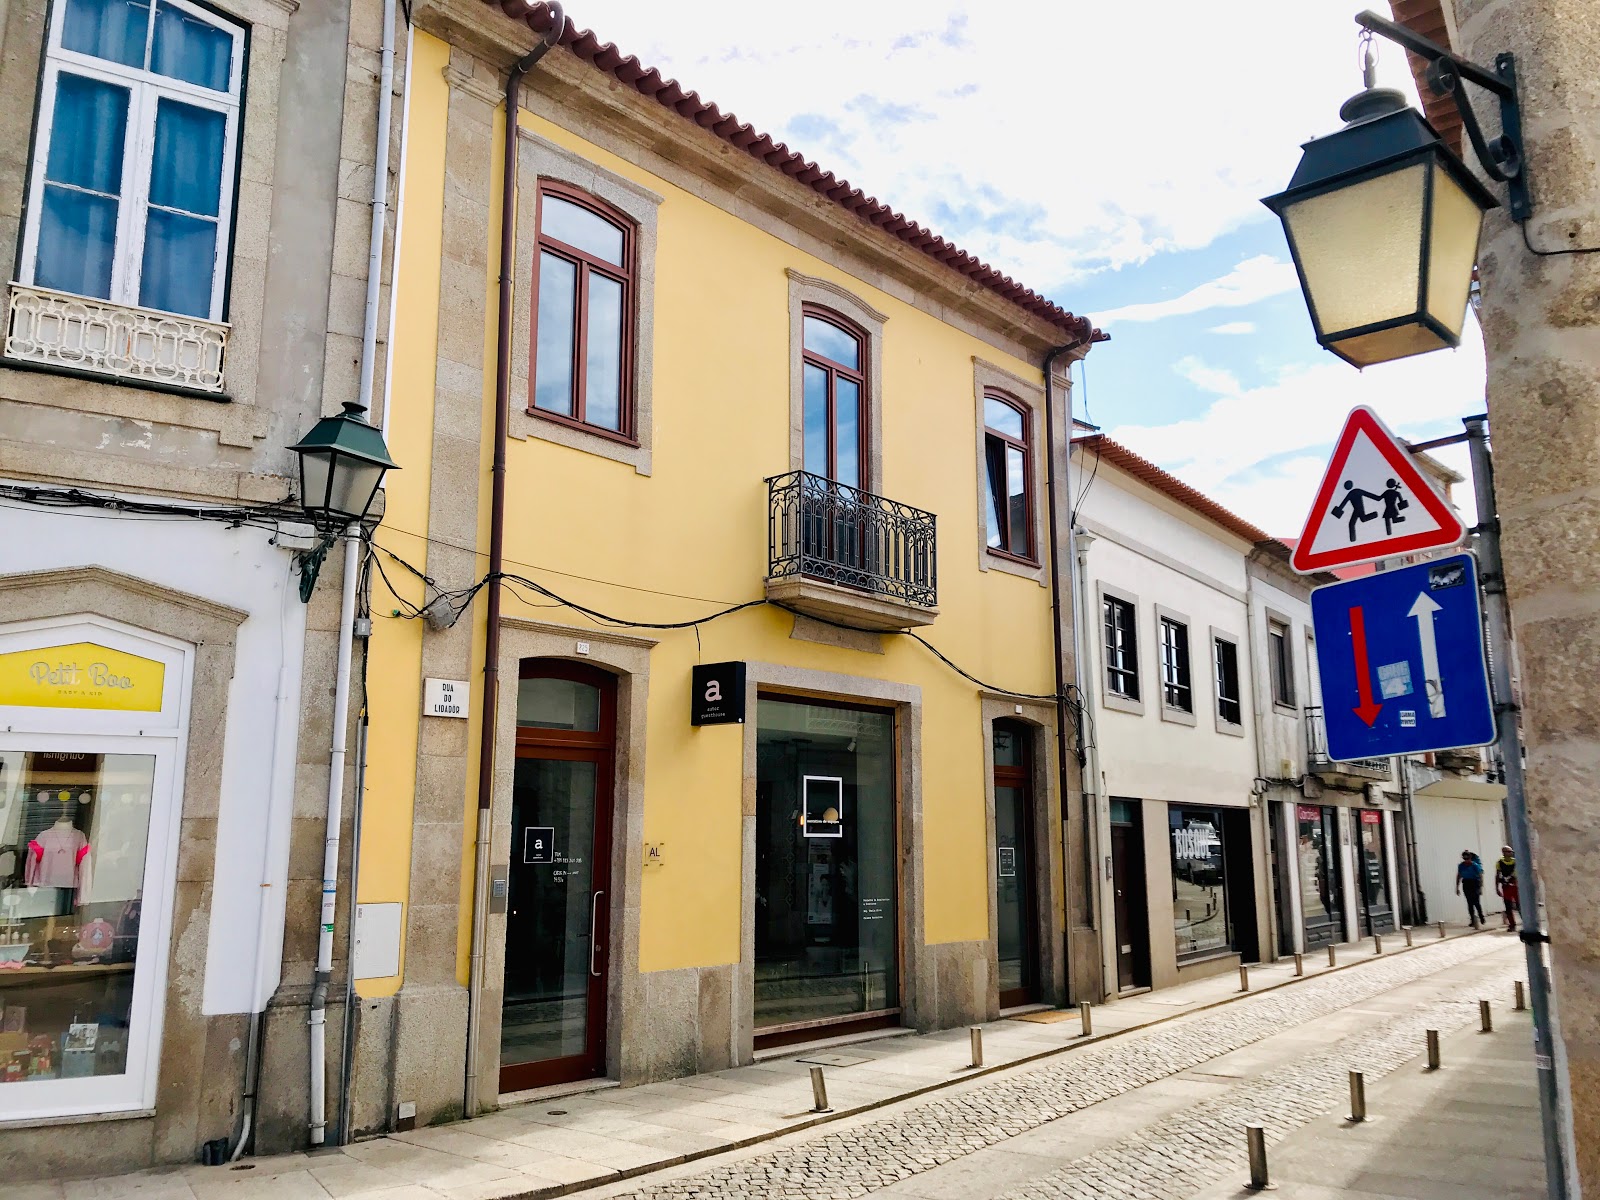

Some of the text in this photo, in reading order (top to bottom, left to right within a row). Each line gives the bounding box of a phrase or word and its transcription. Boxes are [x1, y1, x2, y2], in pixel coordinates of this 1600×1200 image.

[29, 662, 135, 690] Petit Boo
[442, 683, 454, 692] RUA
[704, 680, 722, 702] a
[443, 694, 452, 703] DO
[434, 704, 460, 714] LIDADOR
[534, 838, 544, 849] a
[649, 847, 661, 857] AL
